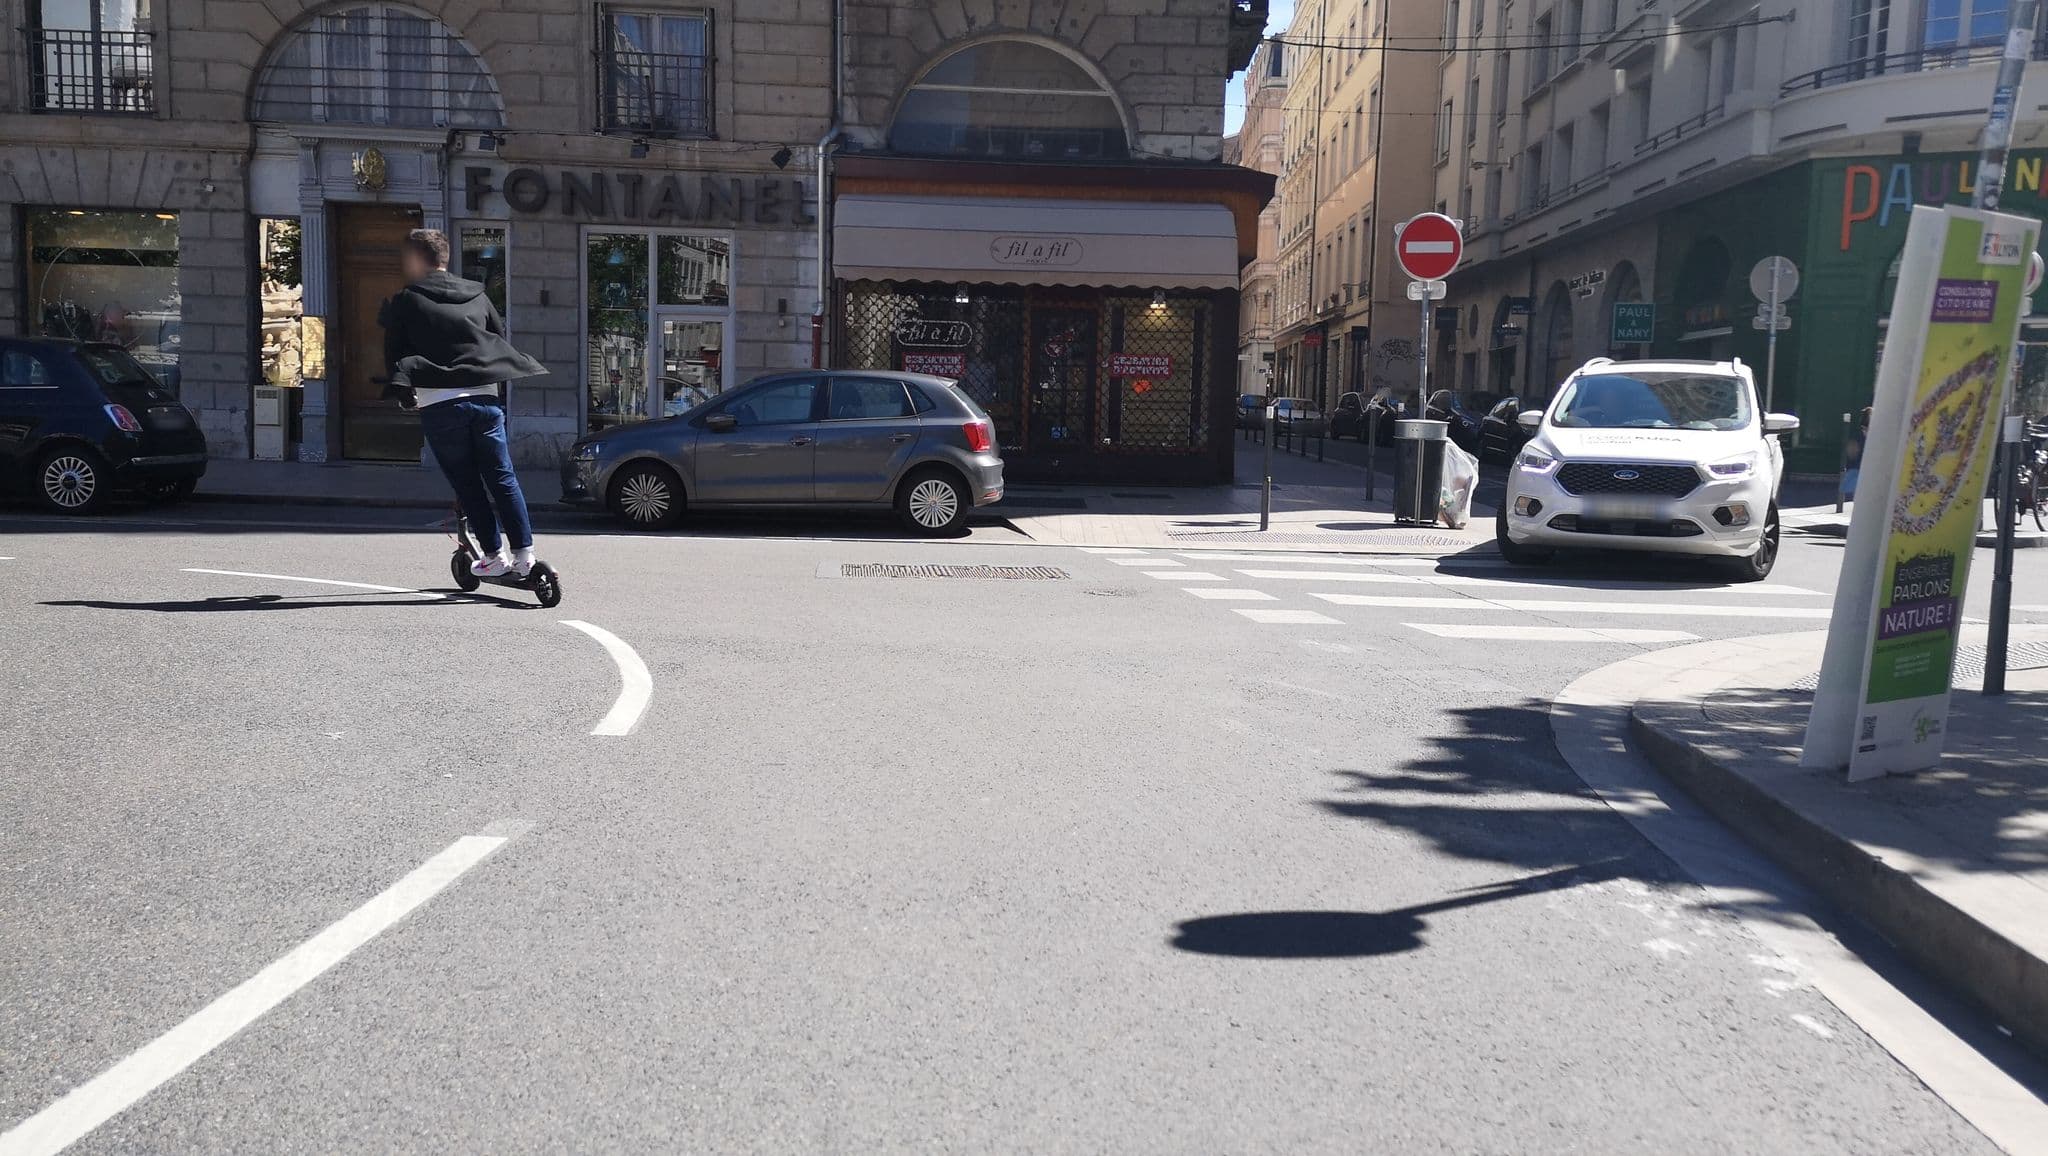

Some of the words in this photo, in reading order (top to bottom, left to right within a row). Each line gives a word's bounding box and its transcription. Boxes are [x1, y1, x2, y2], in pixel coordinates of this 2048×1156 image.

[464, 166, 815, 225] FONTANEL
[1004, 241, 1029, 259] fil
[1618, 307, 1651, 318] PAUL
[1898, 561, 1951, 582] ENSEMBLE
[1893, 578, 1951, 602] PARLONS
[1884, 604, 1946, 633] NATURE
